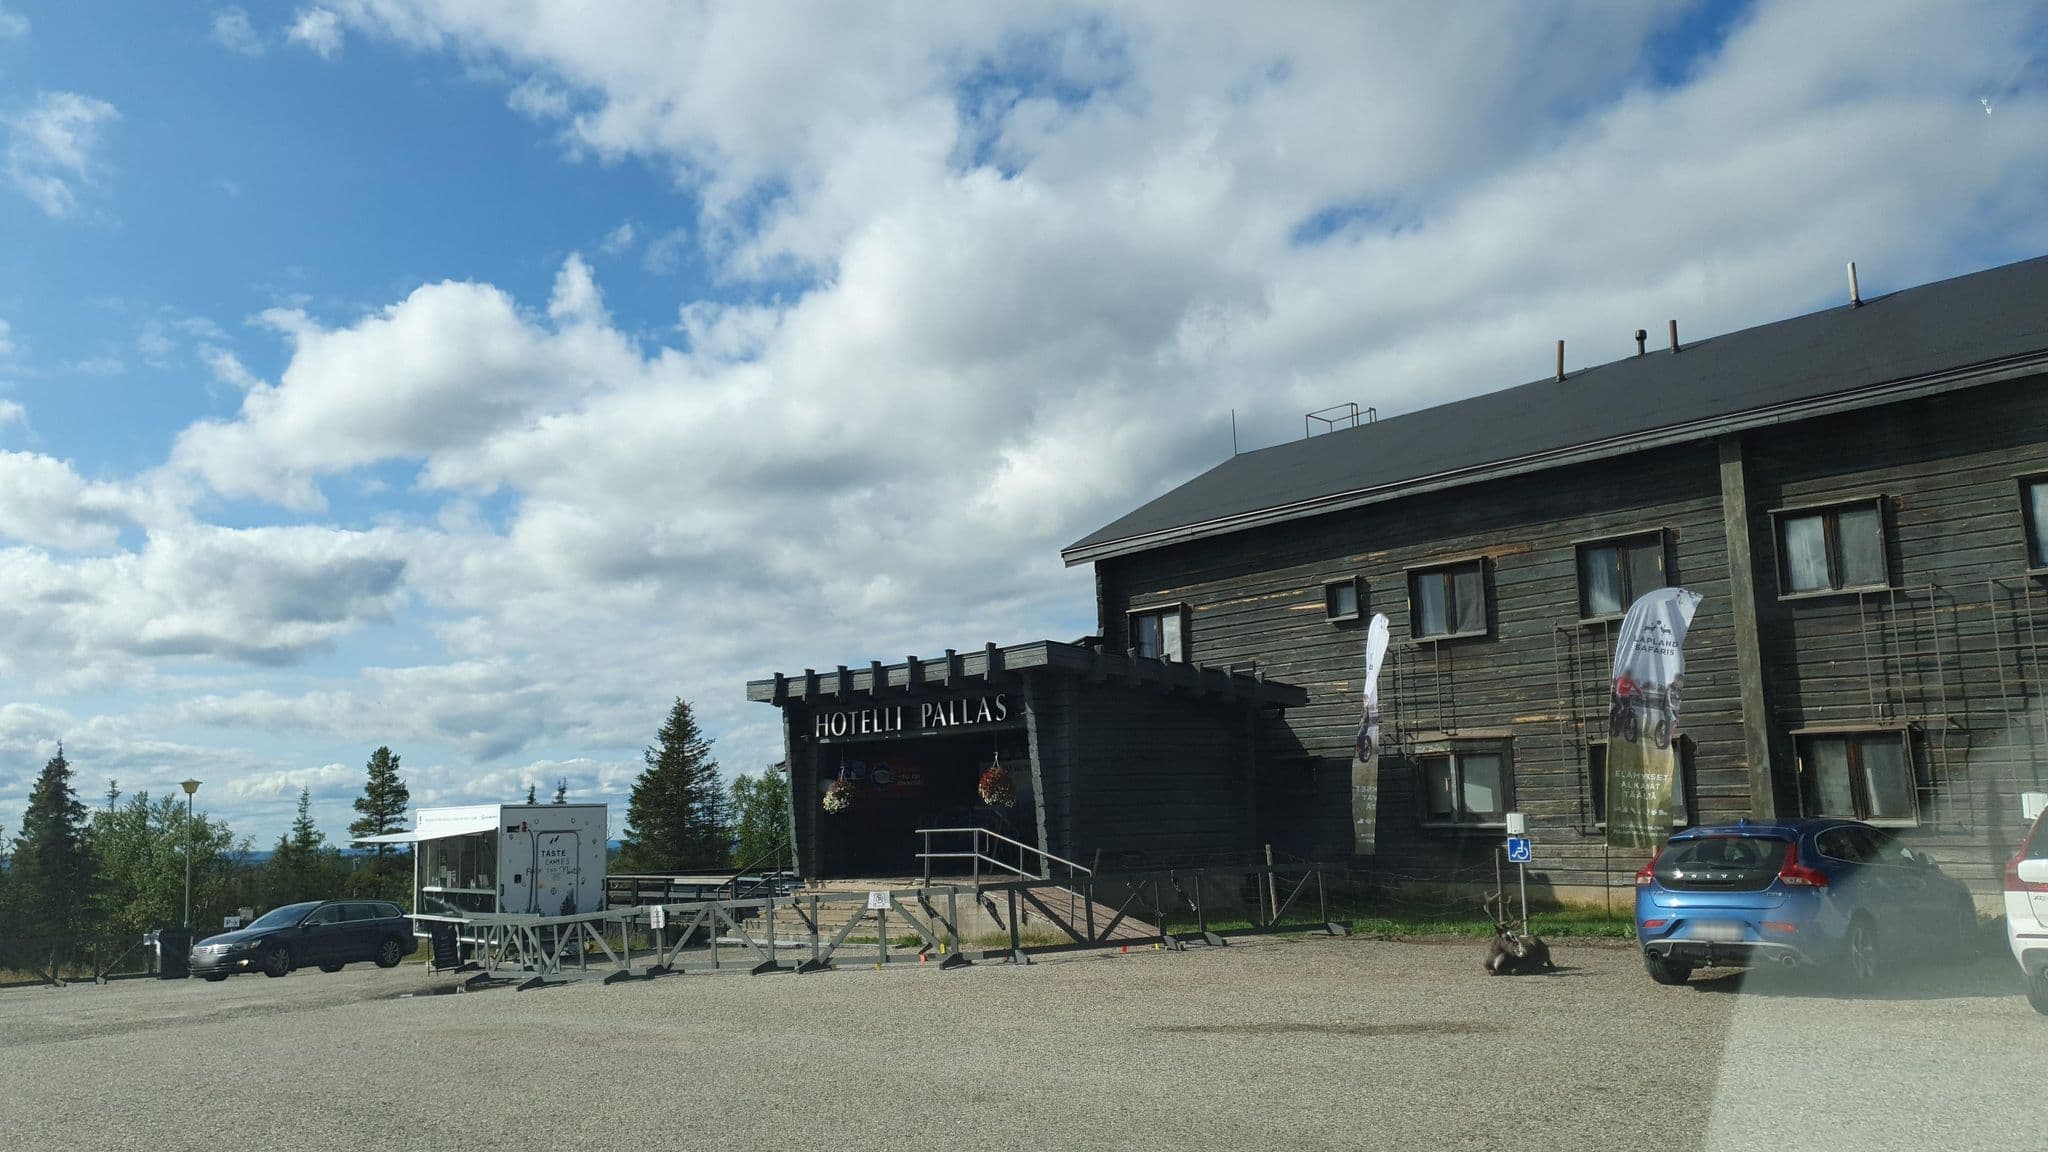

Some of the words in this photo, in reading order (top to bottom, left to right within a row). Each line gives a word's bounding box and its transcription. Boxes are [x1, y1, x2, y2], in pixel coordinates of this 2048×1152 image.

[1633, 634, 1679, 648] LAPLAND
[1635, 643, 1675, 656] SAFARIS
[815, 706, 902, 738] HOTELLI
[921, 693, 1008, 728] PALLAS
[541, 849, 567, 857] TASTE
